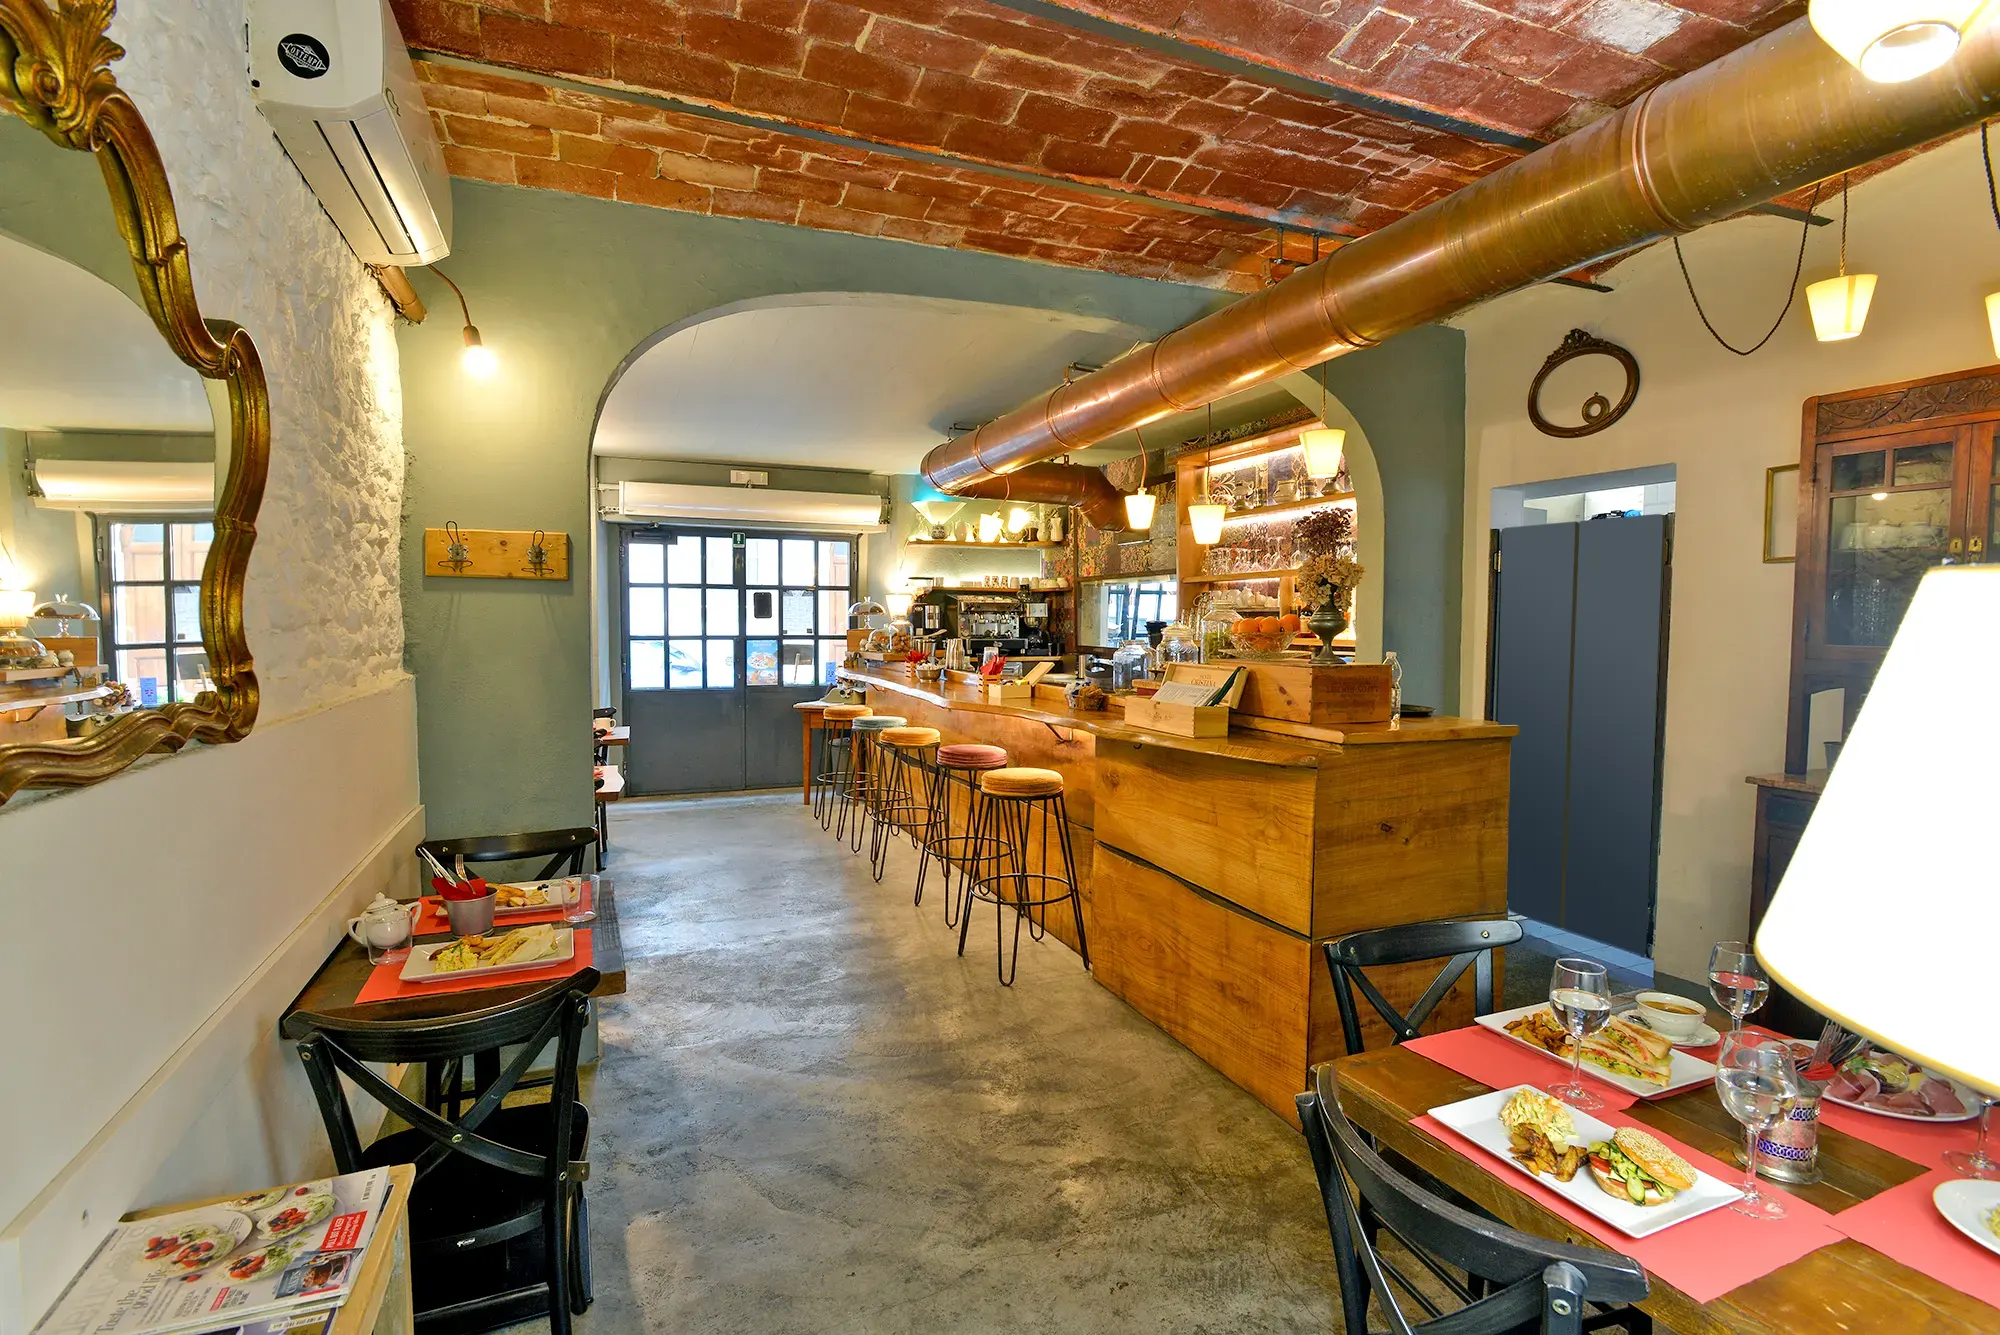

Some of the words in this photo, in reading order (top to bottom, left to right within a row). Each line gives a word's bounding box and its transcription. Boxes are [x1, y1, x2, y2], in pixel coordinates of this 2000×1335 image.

[142, 1269, 168, 1284] life
[132, 1285, 157, 1309] good
[94, 1307, 129, 1335] Taste
[116, 1289, 141, 1305] the
